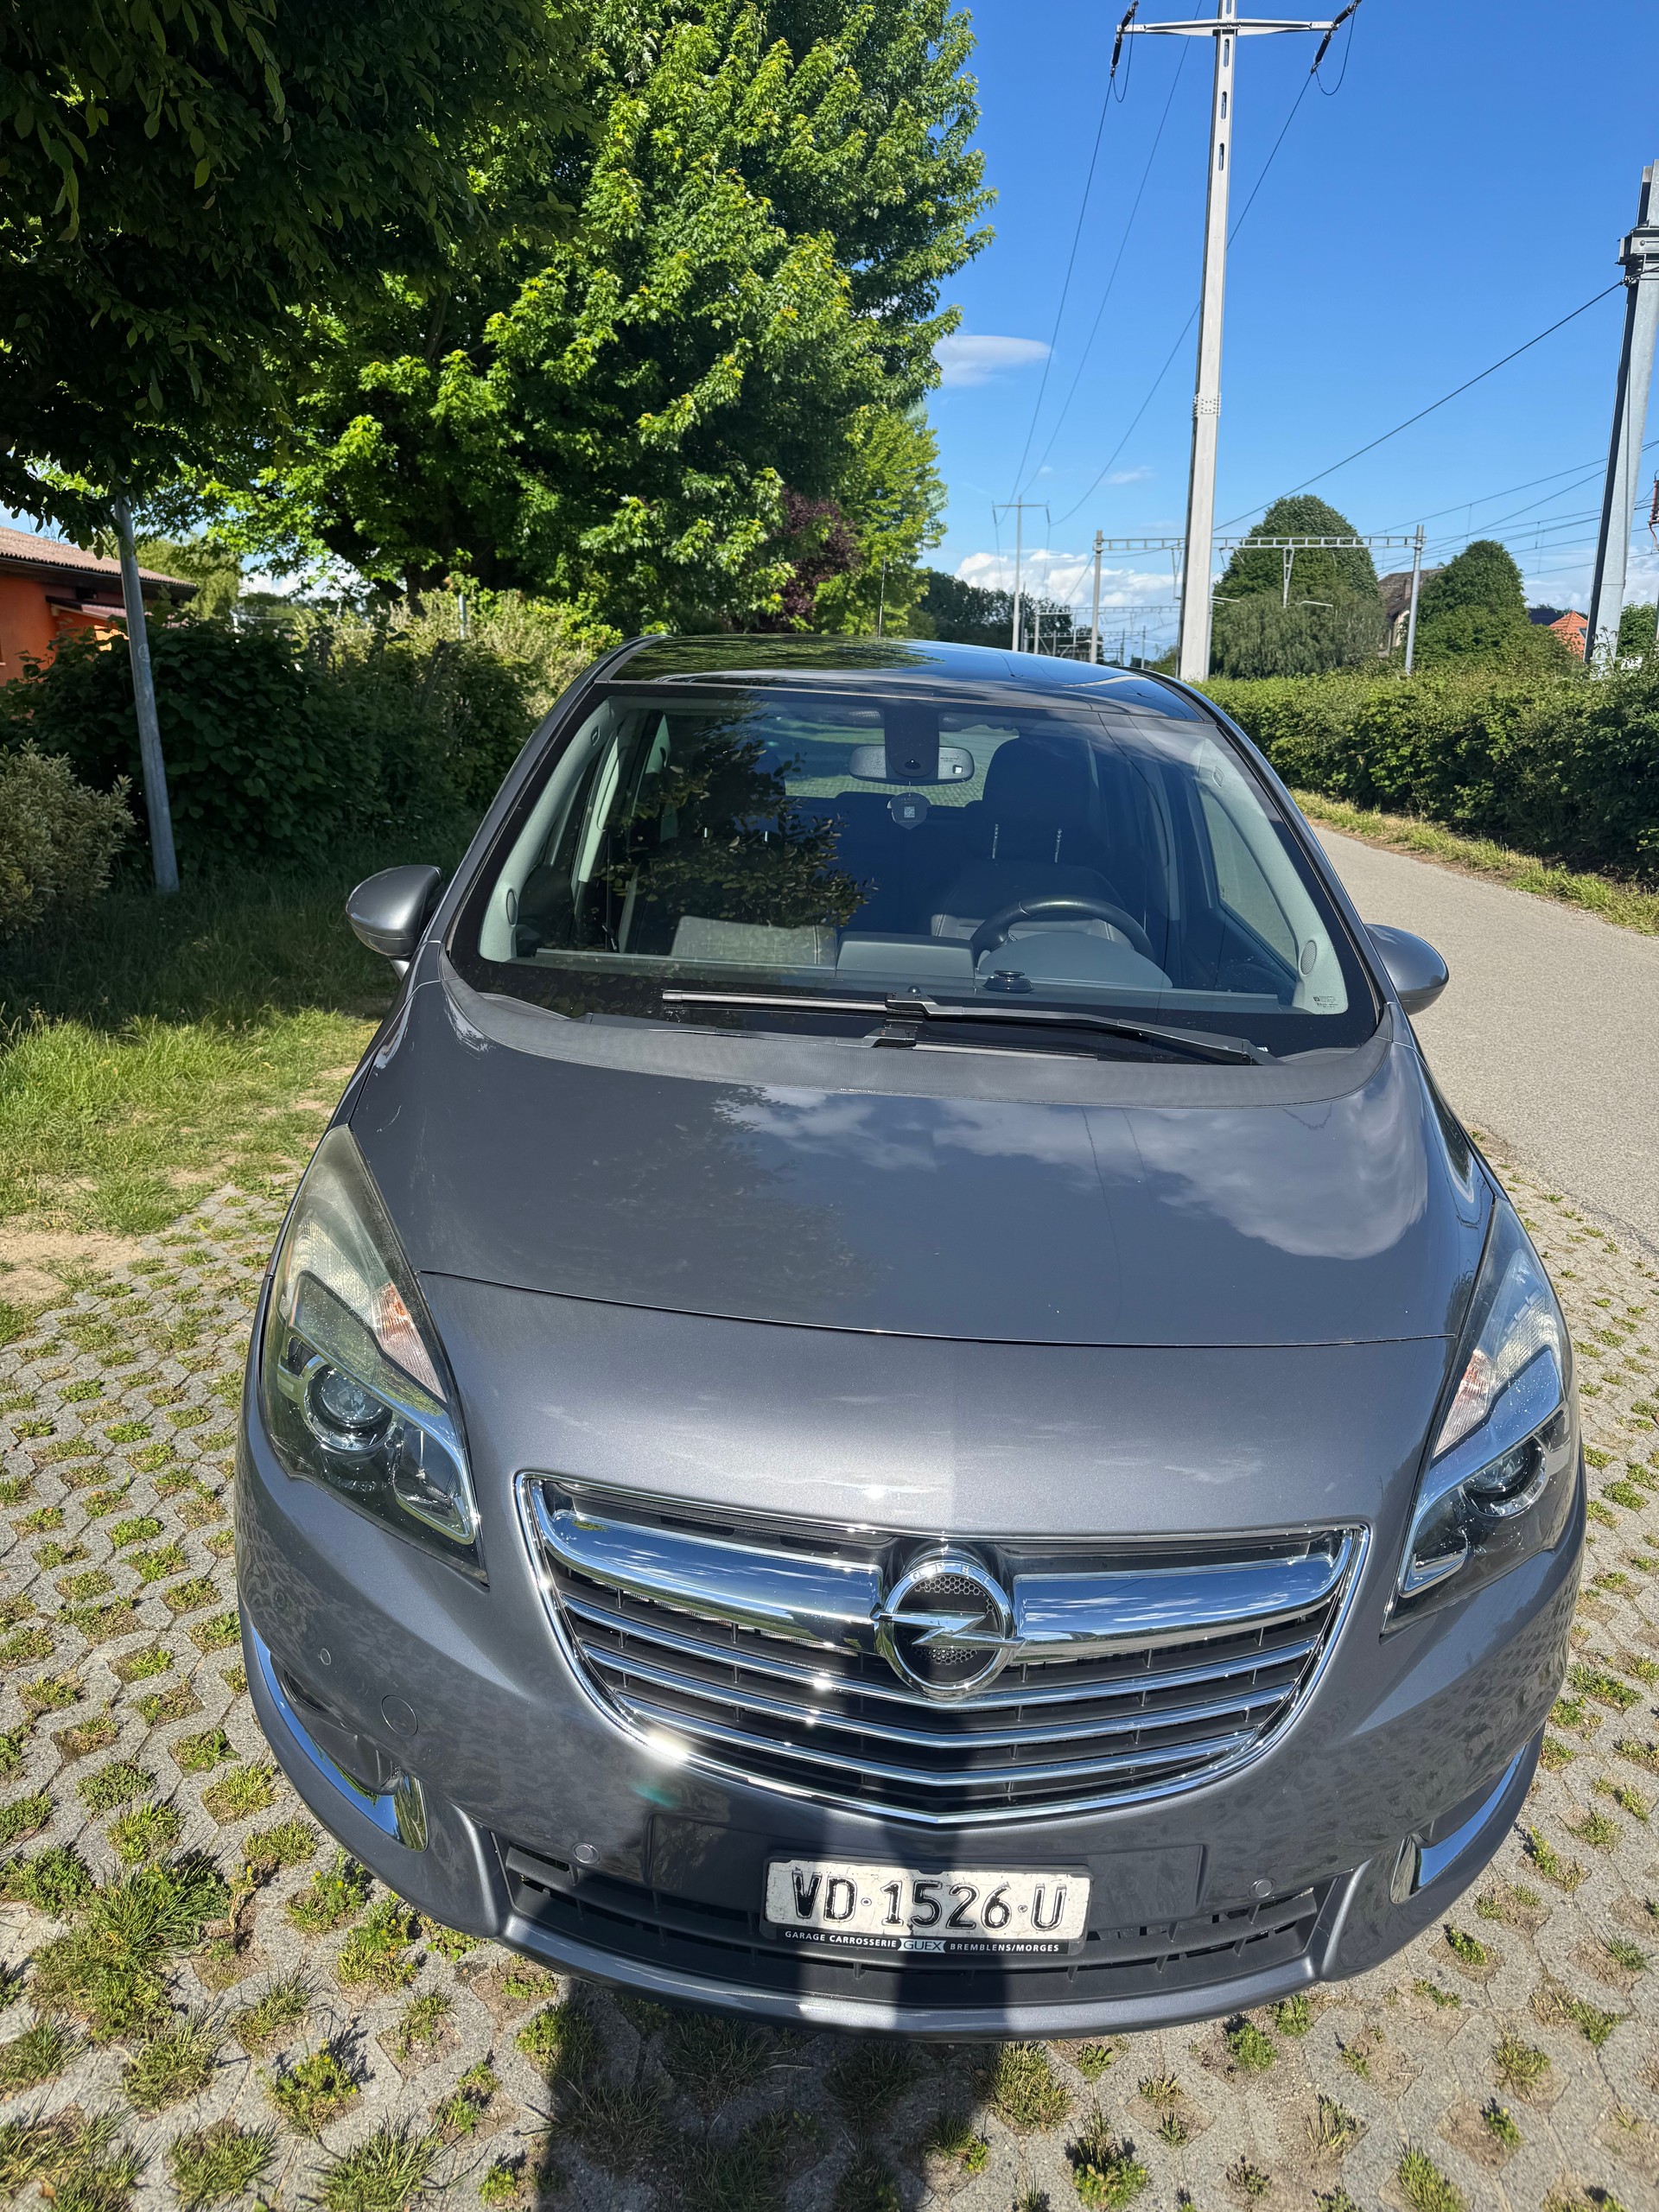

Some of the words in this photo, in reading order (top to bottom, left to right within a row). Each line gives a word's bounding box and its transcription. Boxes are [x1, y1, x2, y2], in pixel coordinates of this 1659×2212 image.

[785, 1930, 825, 1942] GARAGE
[829, 1935, 897, 1948] CARROSSERIE
[903, 1940, 943, 1951] GUEX
[950, 1943, 1059, 1952] BREMBLENS/MORGES
